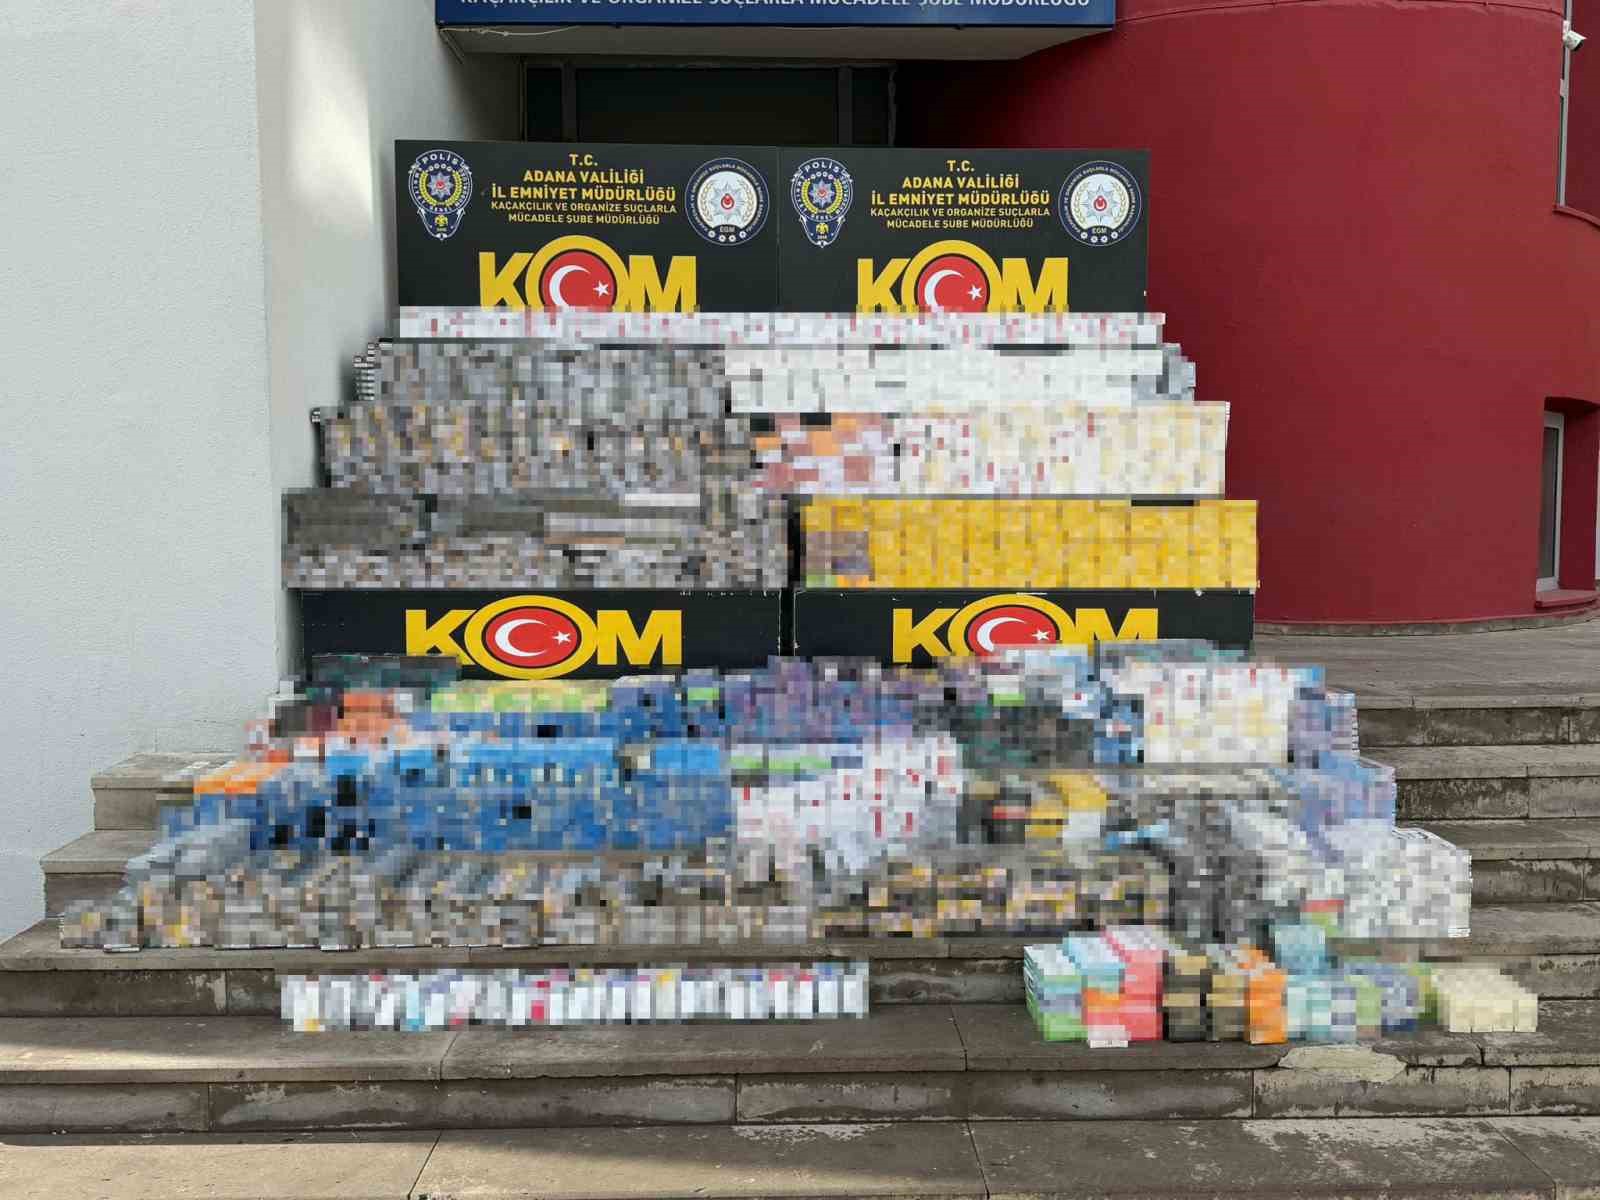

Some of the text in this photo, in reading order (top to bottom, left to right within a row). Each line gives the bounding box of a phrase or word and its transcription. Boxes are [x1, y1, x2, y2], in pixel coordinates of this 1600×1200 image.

[569, 154, 598, 166] T.C.
[947, 160, 975, 172] T.C.
[523, 169, 644, 184] ADANA VALİLİĞİ
[902, 173, 1019, 189] ADANA VALİLİĞİ
[492, 183, 676, 202] İL EMNİYET MÜDÜRLÜĞÜ
[871, 190, 1050, 206] İL EMNİYET MÜDÜRLÜĞÜ
[491, 201, 677, 214] KAÇAKÇILIK VE ORGANİZE SUÇLARLA
[870, 206, 1051, 218] KAÇAKÇILIK VE ORGANİZE SUÇLARLA
[508, 212, 660, 225] MÜCADELE ŞUBE MÜDÜRLÜĞÜ
[887, 218, 940, 229] MÜCADELE
[971, 217, 1034, 229] MÜDÜRLÜĞÜ
[479, 235, 696, 312] KOM
[856, 240, 1069, 312] KOM
[893, 593, 1158, 663] KOM
[405, 595, 682, 679] KOM
